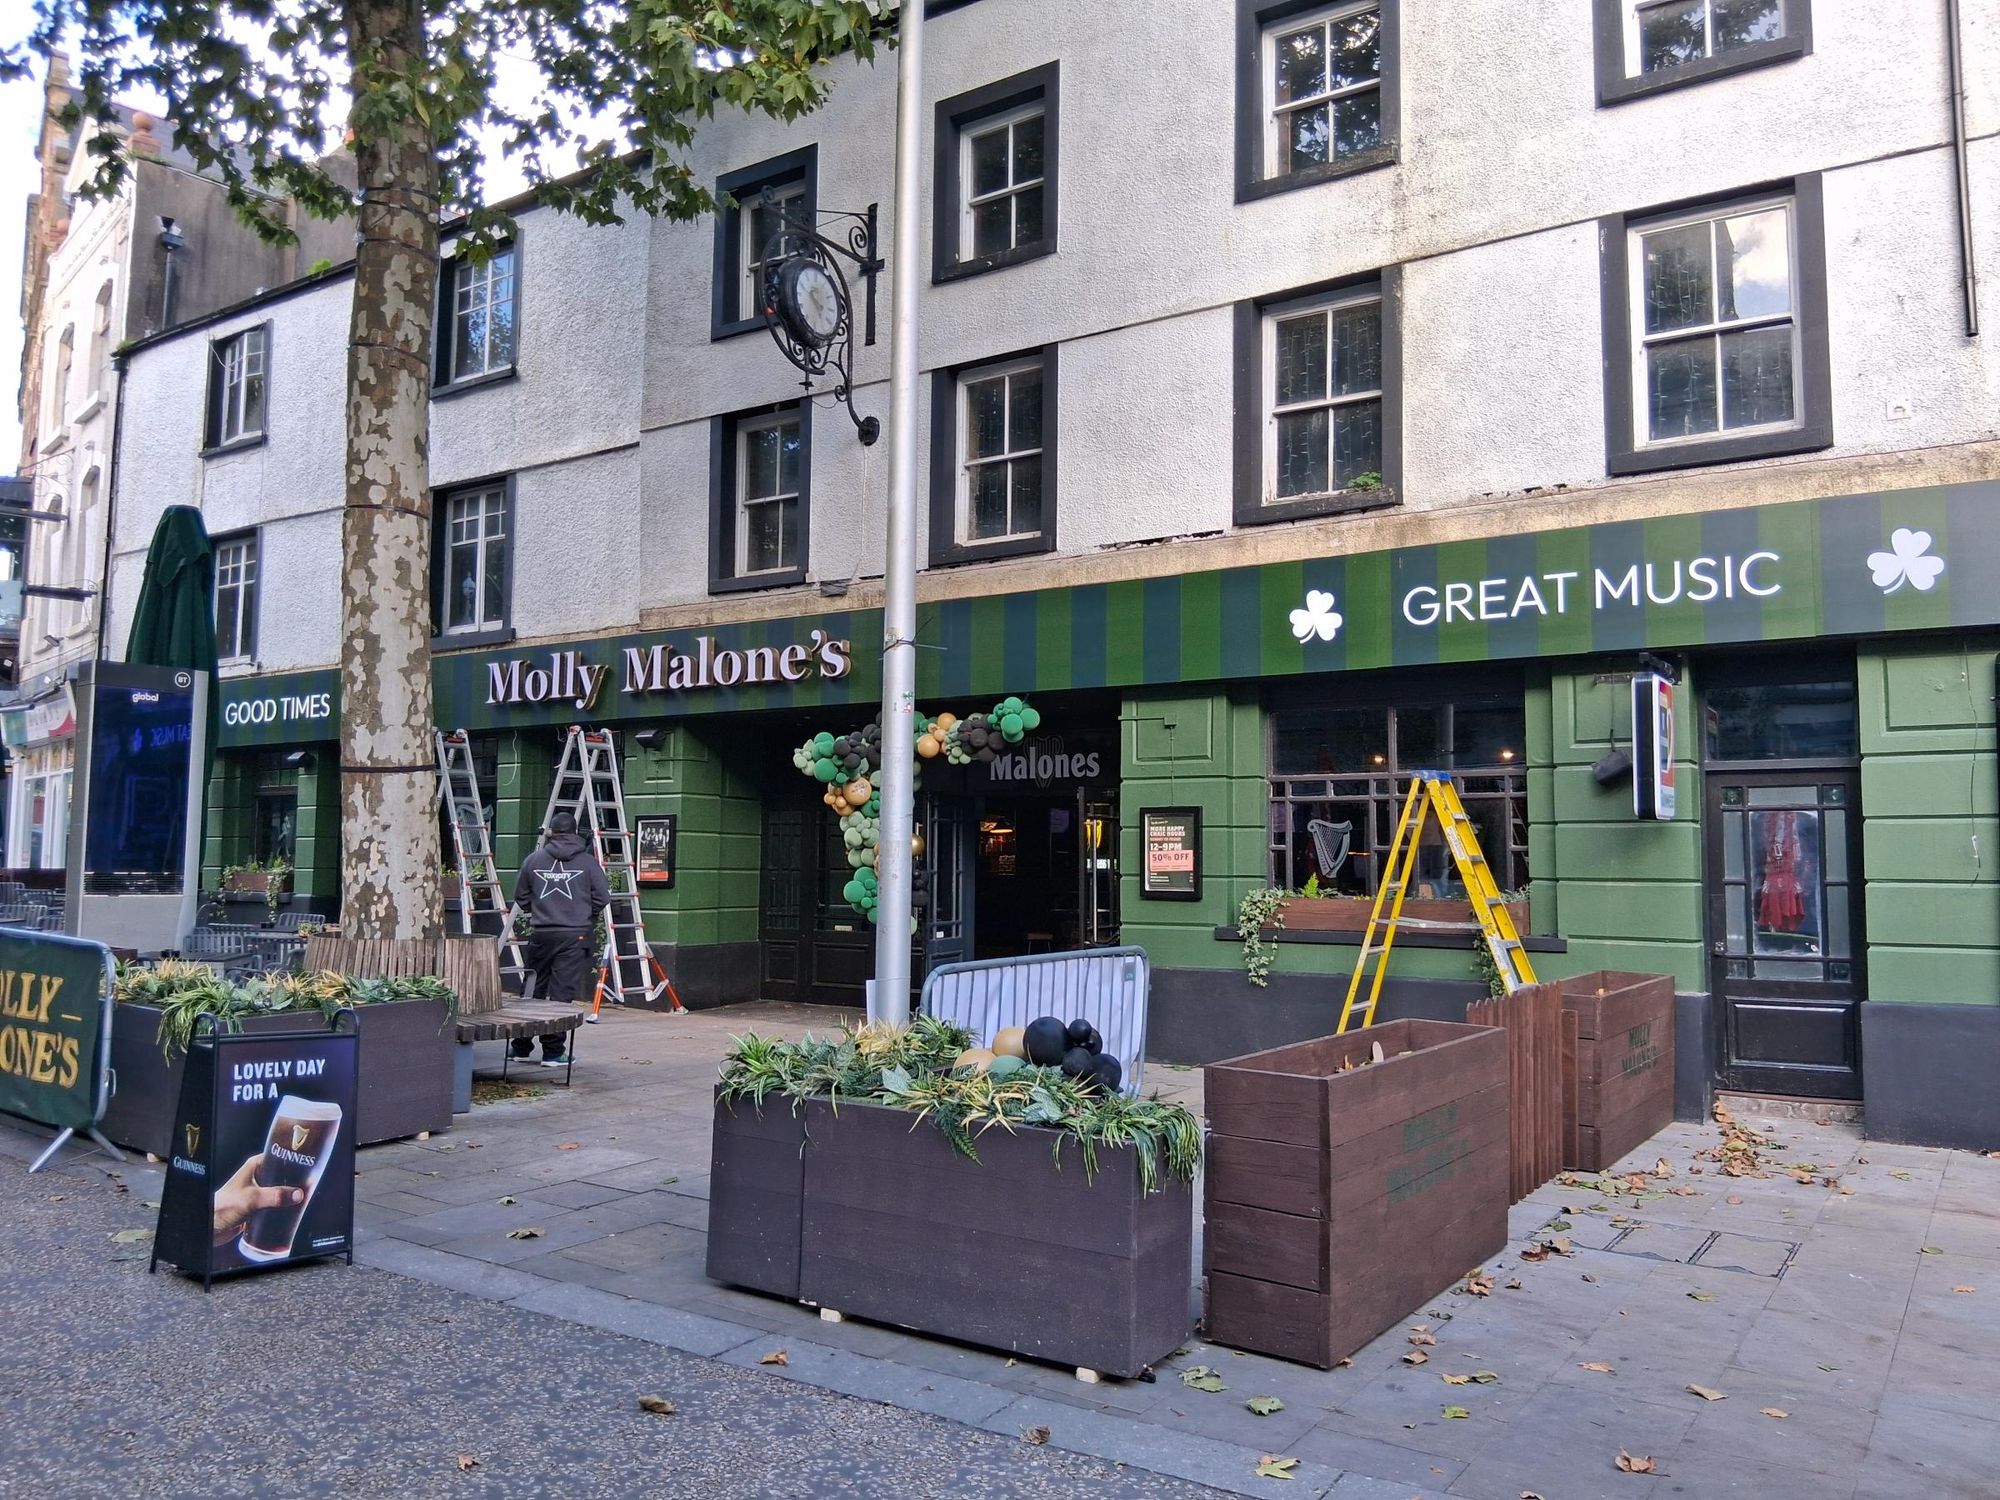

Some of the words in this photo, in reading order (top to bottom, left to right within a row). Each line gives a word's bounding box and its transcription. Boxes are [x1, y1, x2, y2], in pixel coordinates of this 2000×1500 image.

[1402, 571, 1578, 626] GREAT
[1594, 551, 1782, 609] MUSIC
[178, 676, 188, 684] BT
[485, 650, 606, 710] Molly
[621, 629, 851, 693] Malone's
[132, 692, 159, 702] global
[225, 699, 277, 725] GOOD
[280, 693, 331, 720] TIMES
[990, 746, 1100, 780] Malones
[1174, 853, 1189, 861] OFF
[0, 969, 64, 1023] LLY
[234, 1061, 292, 1080] LOVELY
[296, 1059, 326, 1076] DAY
[233, 1083, 264, 1102] FOR
[268, 1082, 279, 1099] A
[173, 1156, 206, 1175] GUINNESS
[271, 1142, 316, 1167] GUINNESS
